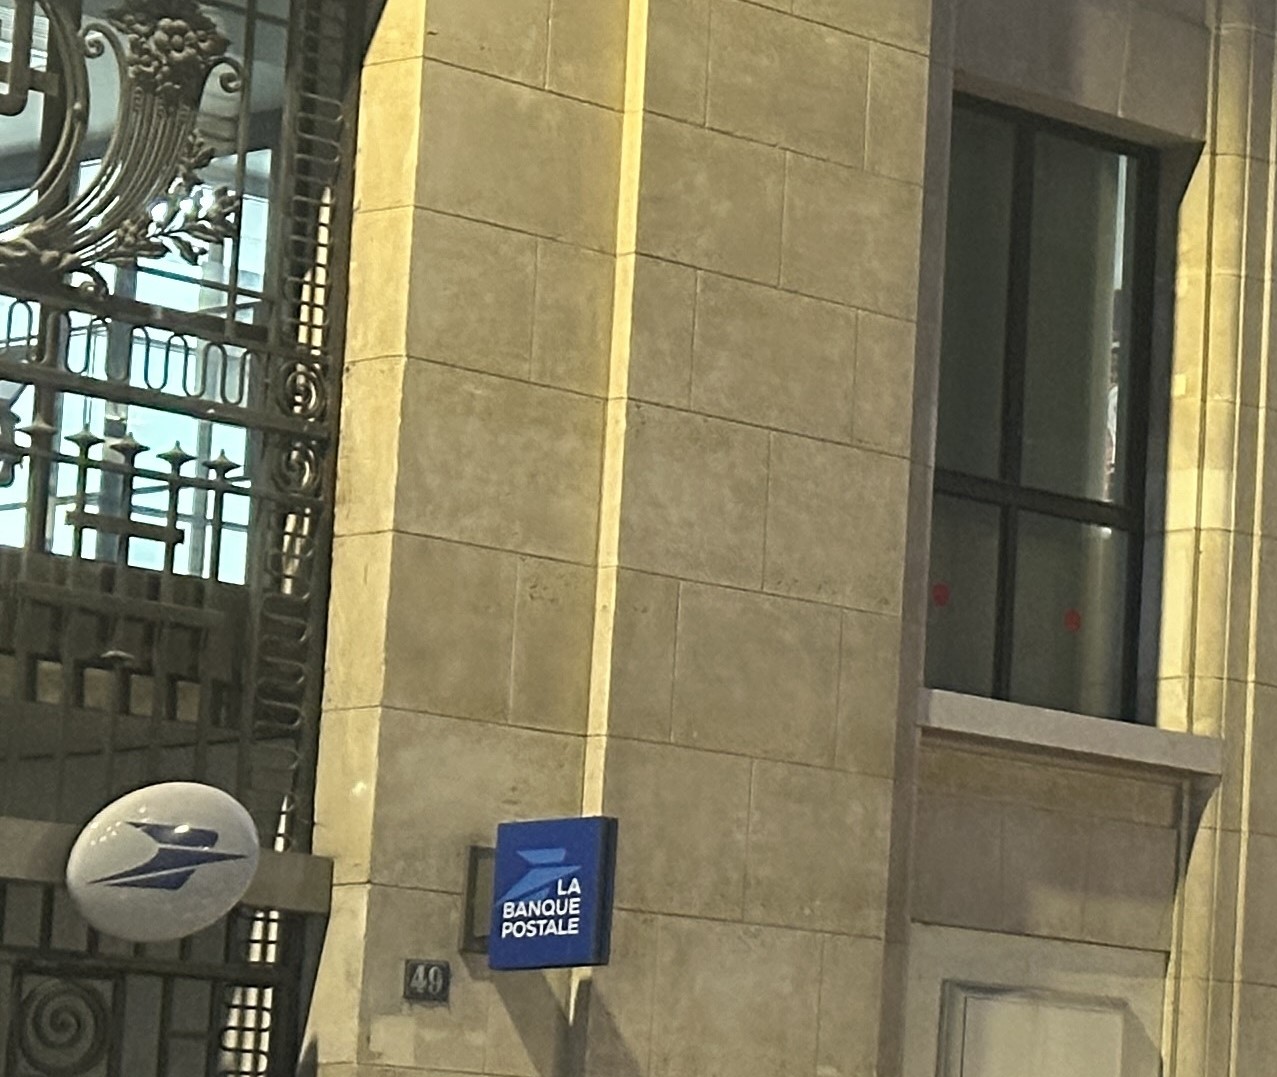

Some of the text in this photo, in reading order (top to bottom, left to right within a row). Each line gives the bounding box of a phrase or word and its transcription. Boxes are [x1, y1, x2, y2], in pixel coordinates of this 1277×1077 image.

[557, 878, 581, 895] LA
[502, 897, 581, 919] BANQUE
[501, 917, 580, 938] POSTALE
[410, 964, 444, 994] 49
